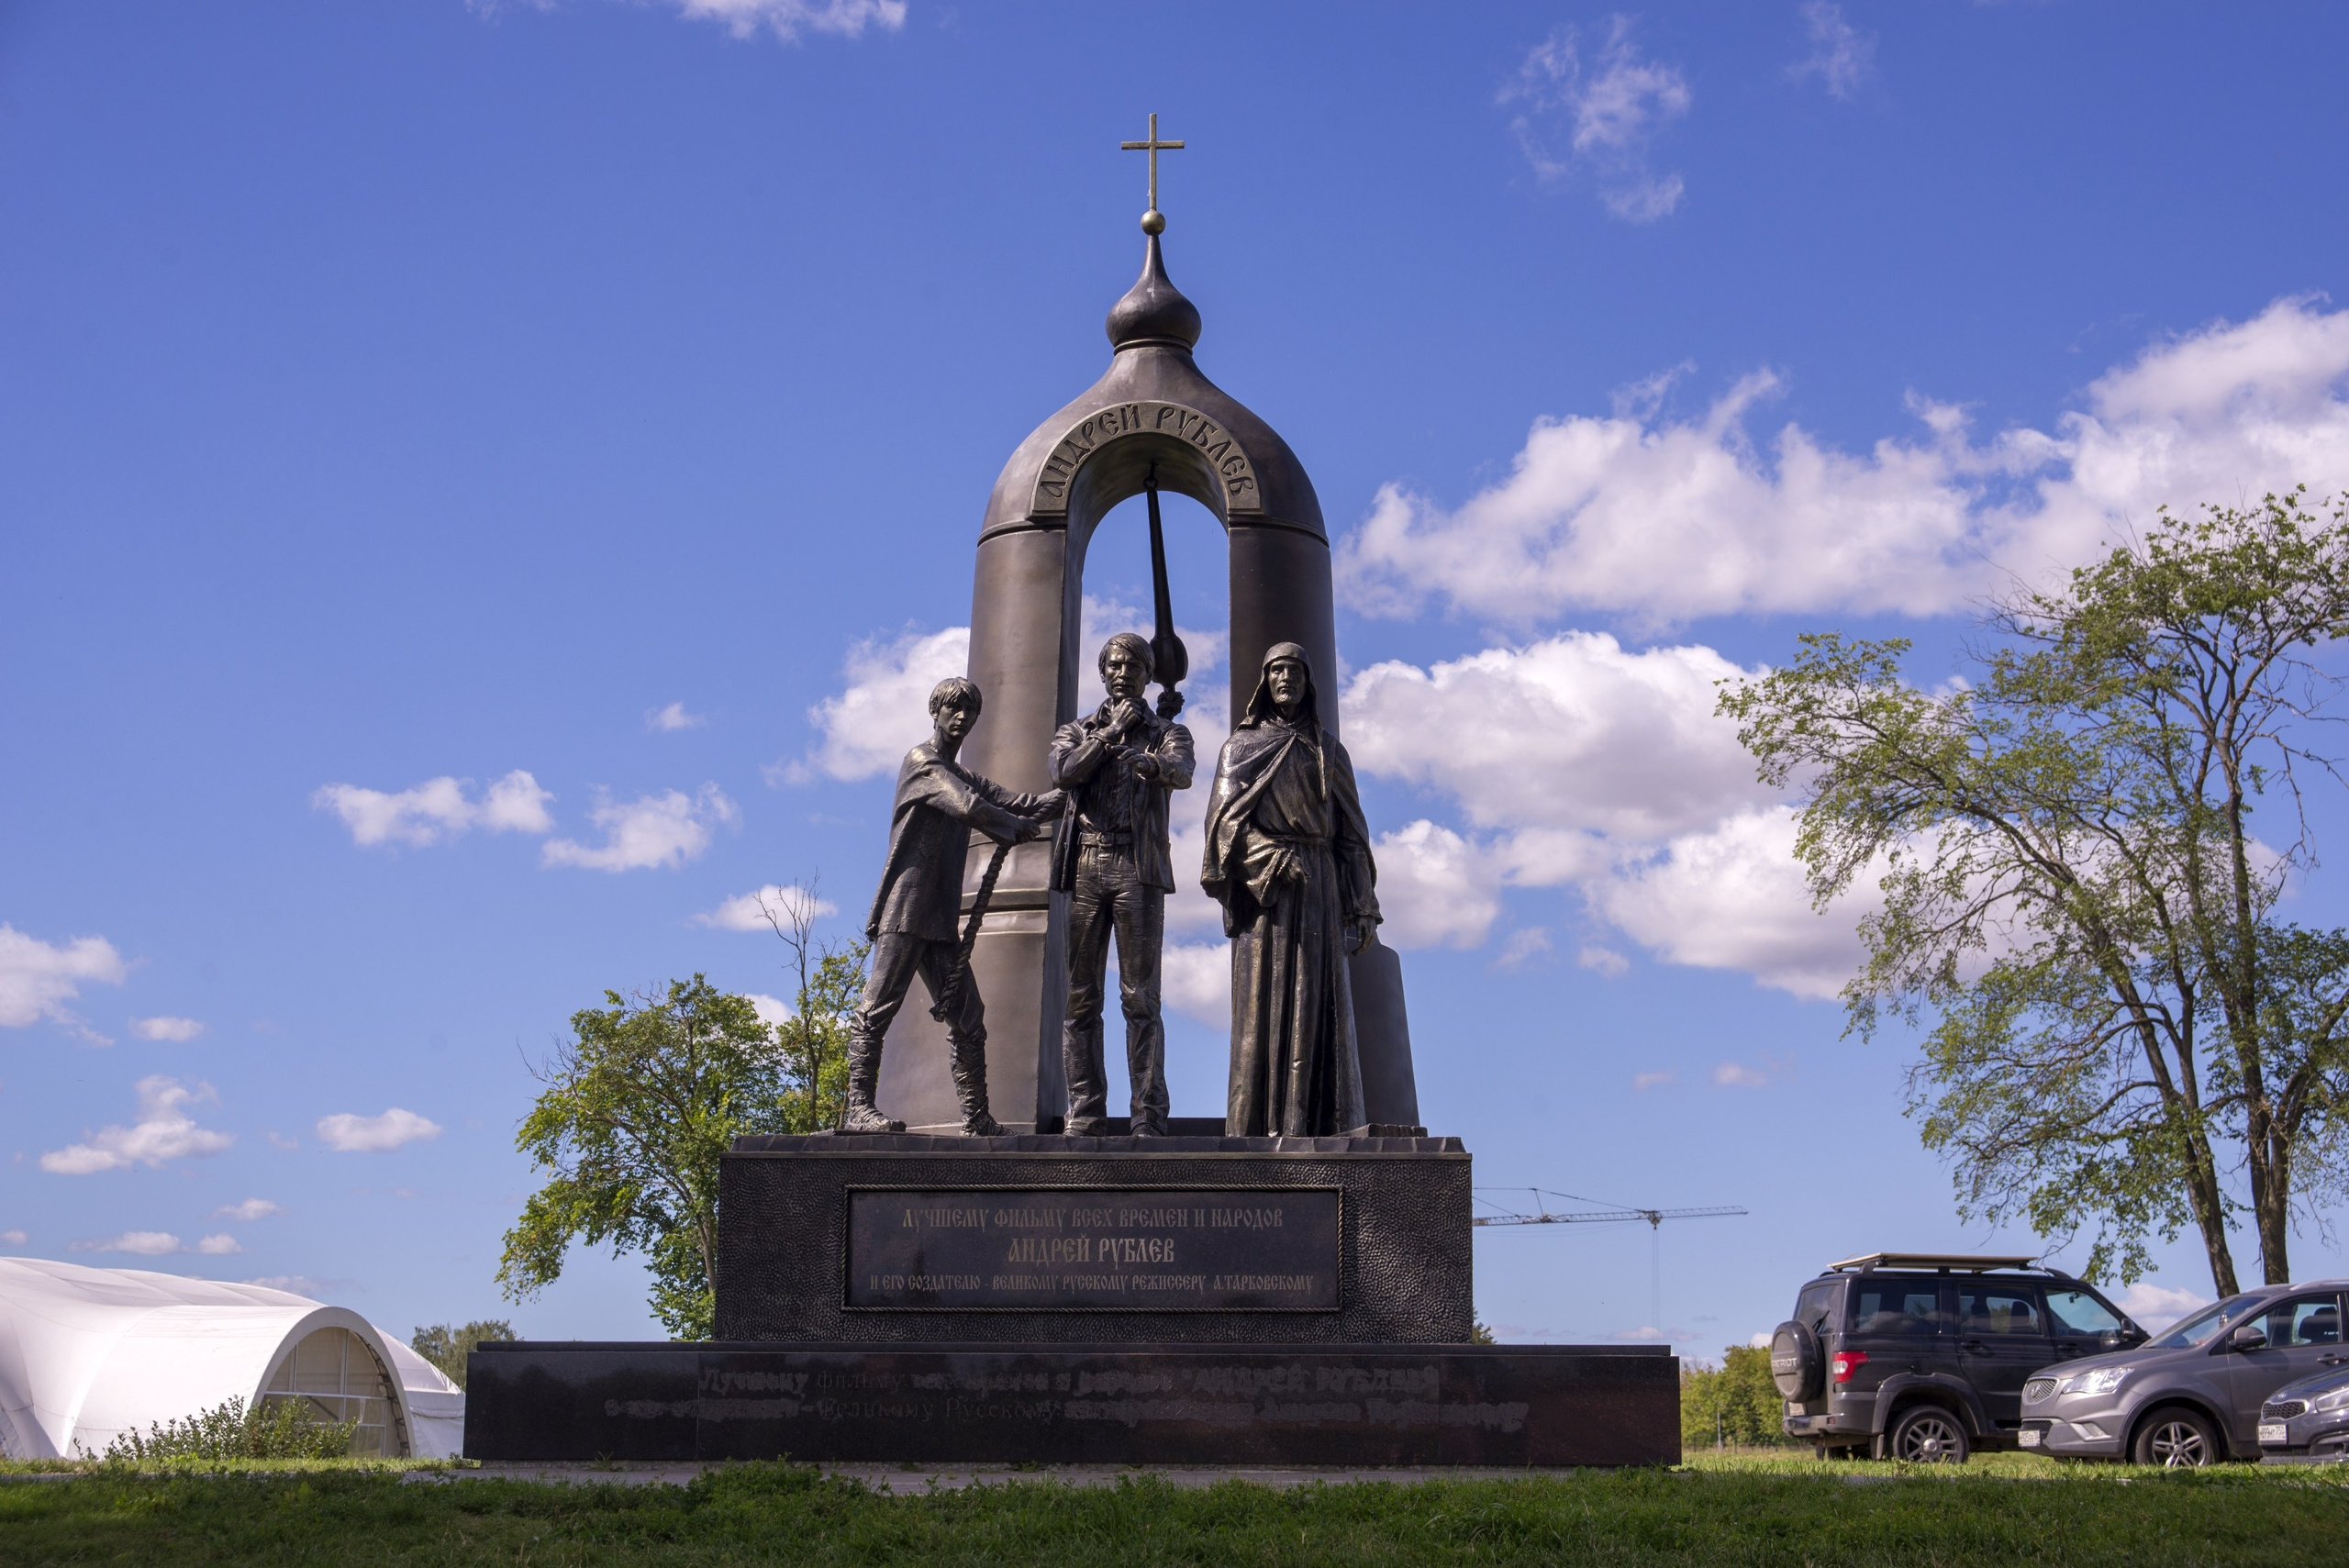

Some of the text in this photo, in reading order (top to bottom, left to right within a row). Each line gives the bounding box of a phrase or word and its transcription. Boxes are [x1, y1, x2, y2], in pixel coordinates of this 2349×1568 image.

[1039, 404, 1254, 498] АНДРЕЙ РУБЛЕВ
[902, 1208, 1283, 1233] ЛУЧШЕМУ ФИЛЬМУ ВСЕХ ВРЕМЕН И НАРОДОВ
[1008, 1232, 1174, 1270] АНДРЕЙ РУБЛЕВ
[870, 1274, 879, 1290] И
[882, 1274, 905, 1290] ЕГО
[907, 1274, 981, 1293] СОЗДАТЕЛЮ
[992, 1274, 1058, 1295] ВЕЛИКОМУ
[1062, 1274, 1128, 1295] РУССКОМУ
[1131, 1274, 1206, 1295] РЕЖИССЕРУ
[1213, 1274, 1314, 1295] А.ТАРКОВСКОМУ
[1771, 1357, 1798, 1368] PATRIOT
